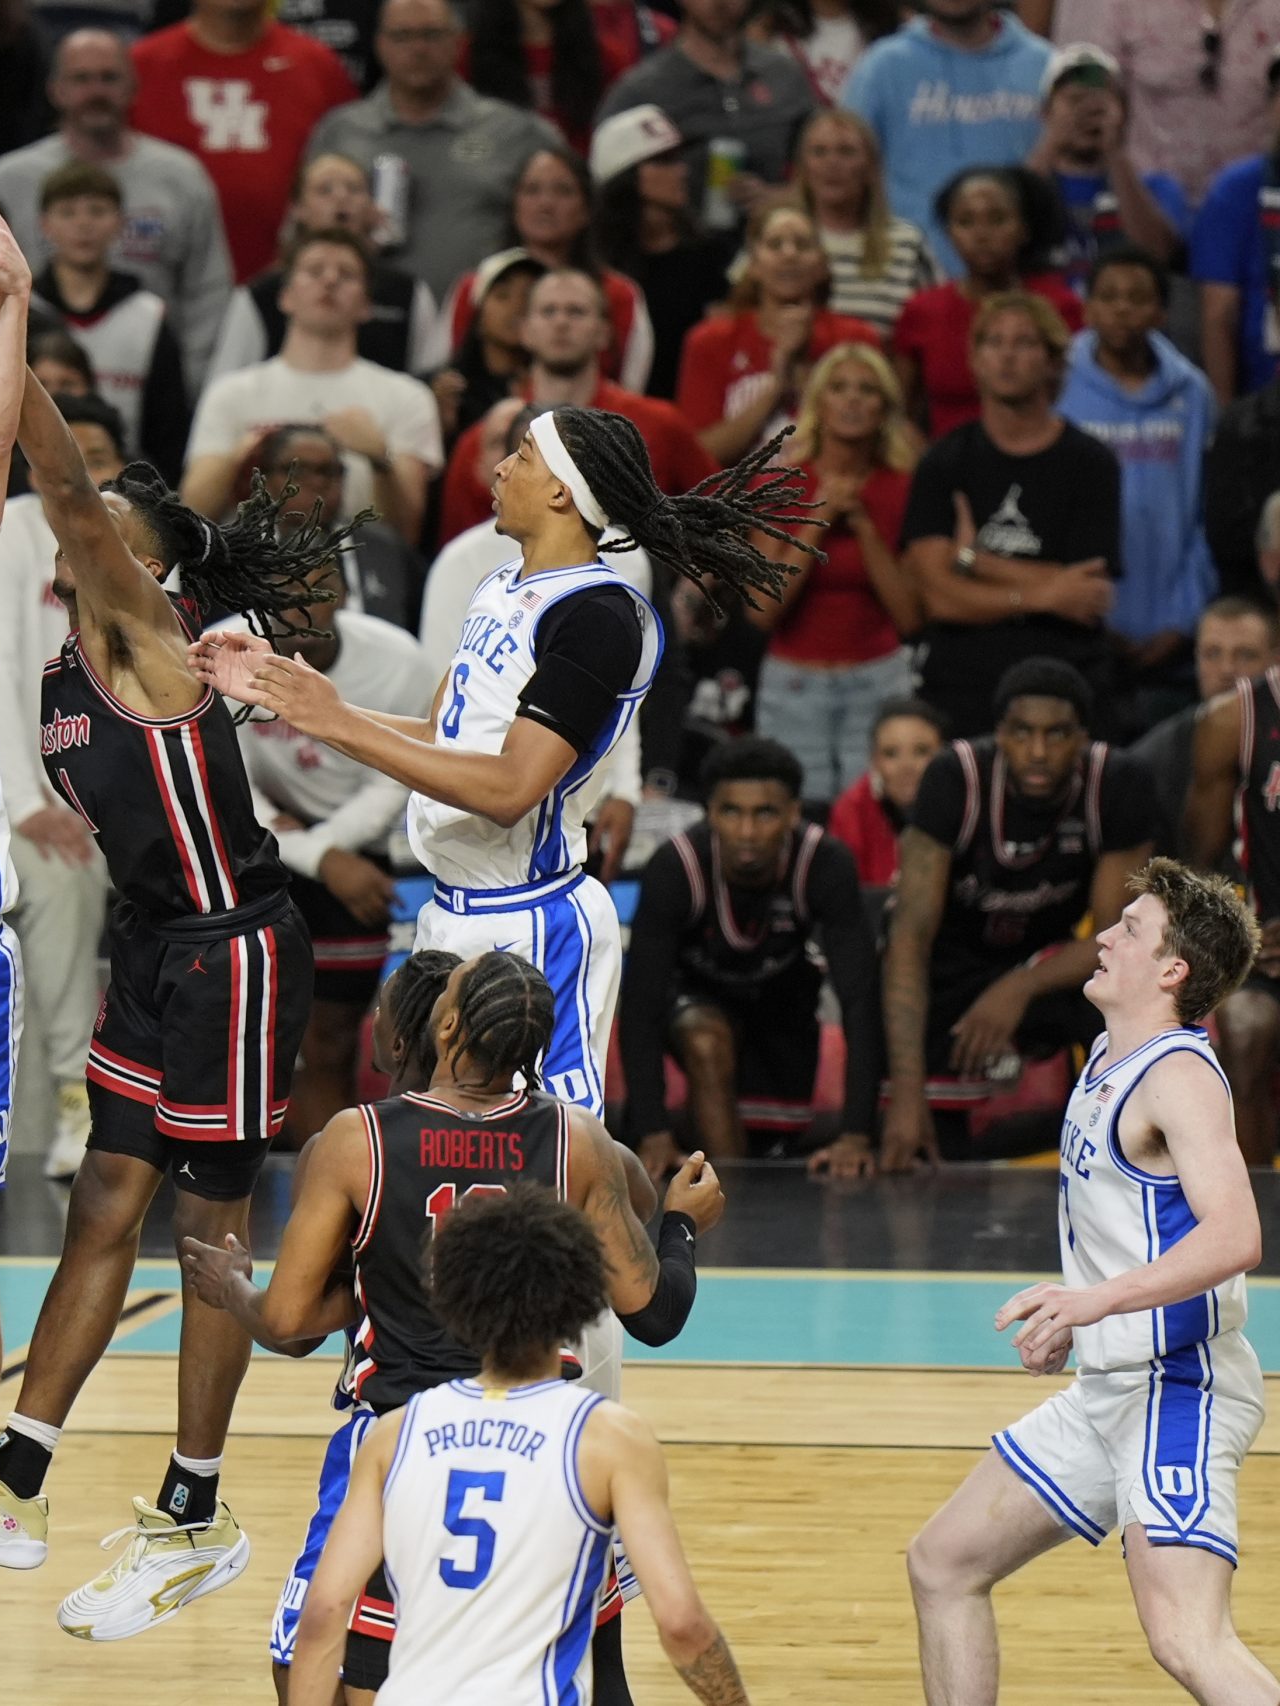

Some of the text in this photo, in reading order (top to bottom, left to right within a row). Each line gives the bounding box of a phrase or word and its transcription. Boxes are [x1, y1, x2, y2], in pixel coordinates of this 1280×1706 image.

[442, 663, 470, 739] 6
[420, 1128, 525, 1171] ROBERTS
[426, 1183, 508, 1241] 1
[424, 1419, 546, 1462] PROCTOR
[439, 1468, 506, 1590] 5
